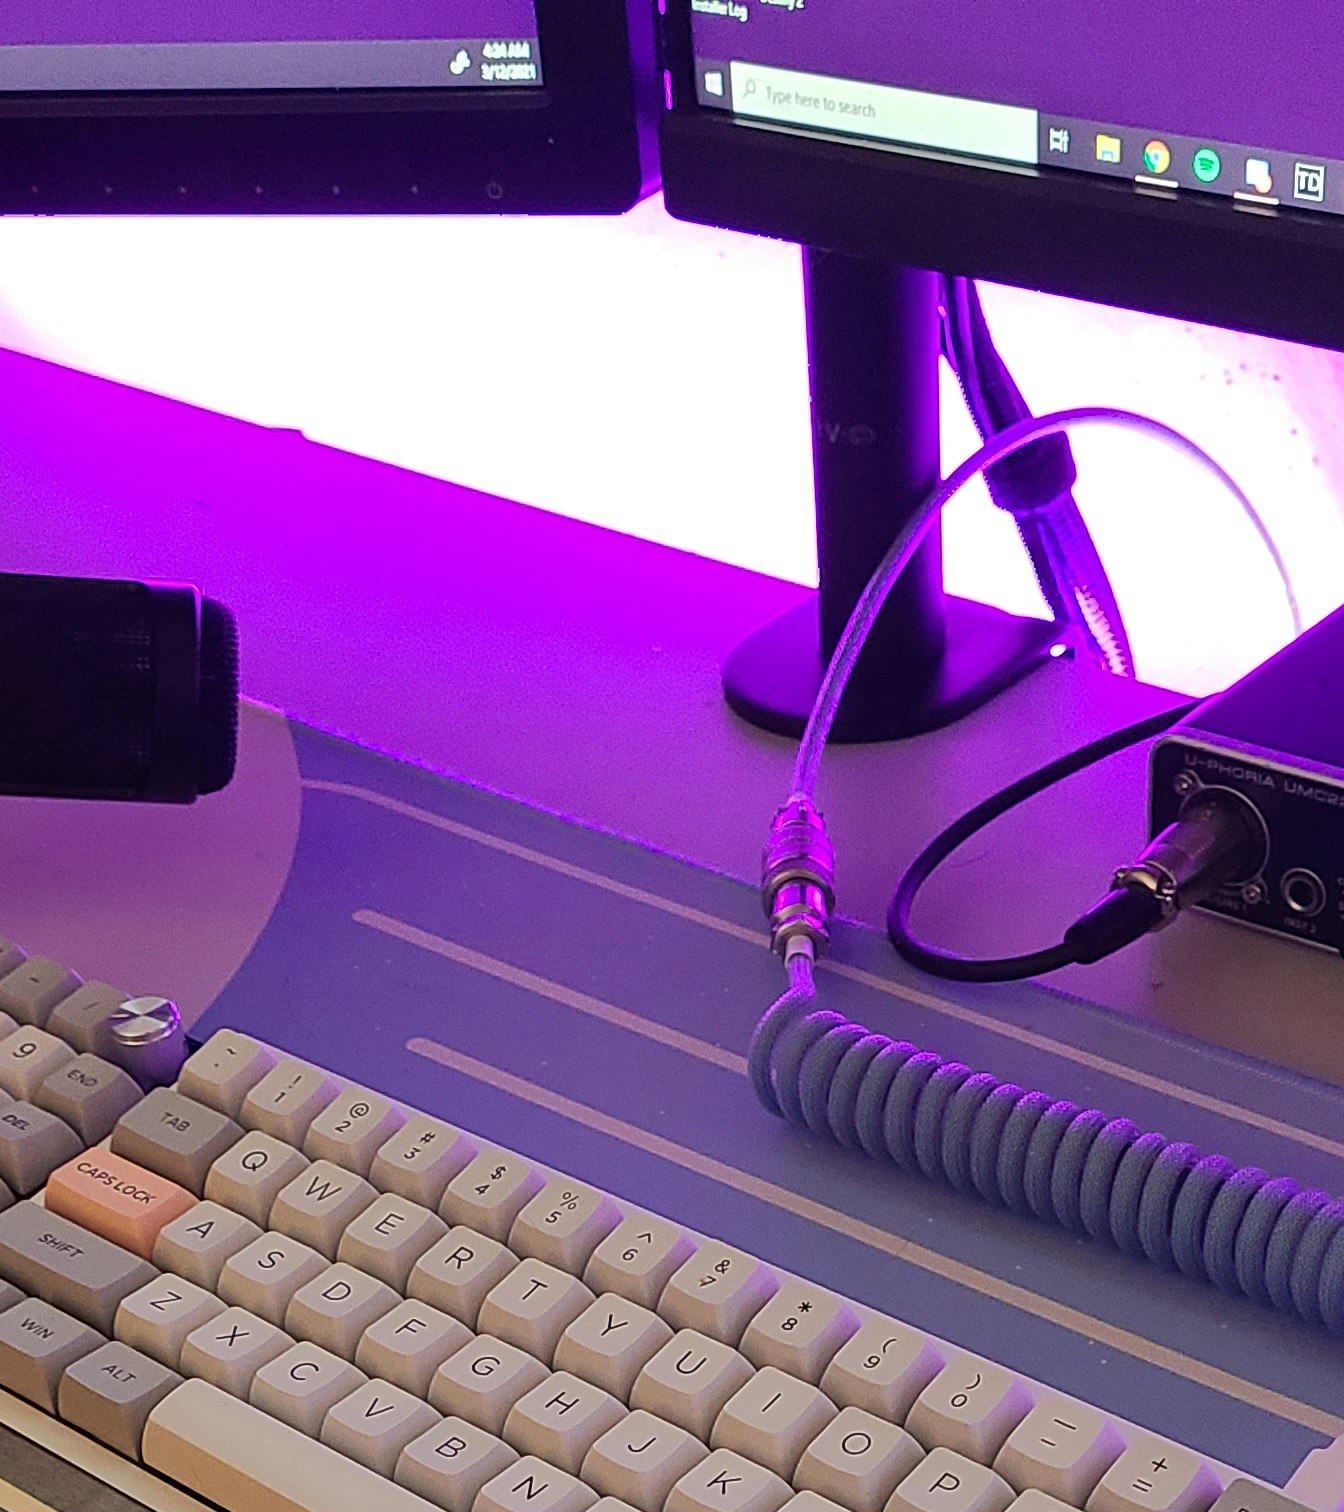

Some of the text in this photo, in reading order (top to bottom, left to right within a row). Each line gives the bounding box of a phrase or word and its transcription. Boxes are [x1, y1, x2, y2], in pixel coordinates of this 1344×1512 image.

[766, 86, 876, 118] Type here to search
[12, 1042, 37, 1059] 9
[66, 1068, 98, 1087] END
[274, 1091, 287, 1103] 1
[1, 1114, 30, 1131] DEL
[161, 1111, 191, 1132] TAB
[334, 1120, 352, 1133] 2
[241, 1150, 269, 1172] Q
[403, 1147, 421, 1160] 3
[77, 1162, 157, 1205] CAPS LOCK
[305, 1175, 343, 1202] W
[374, 1212, 405, 1235] E
[544, 1210, 562, 1224] 5
[185, 1221, 215, 1239] A
[37, 1233, 84, 1258] SHIFT
[622, 1248, 639, 1261] 6
[257, 1250, 285, 1269] S
[444, 1246, 474, 1270] R
[321, 1281, 352, 1301] D
[521, 1278, 549, 1301] T
[699, 1275, 717, 1287] 7
[149, 1291, 183, 1311] Z
[20, 1318, 55, 1339] WIN
[394, 1318, 427, 1334] F
[600, 1313, 629, 1337] Y
[781, 1317, 799, 1331] 8
[215, 1325, 250, 1347] X
[289, 1362, 320, 1381] C
[471, 1356, 501, 1376] G
[675, 1350, 707, 1375] U
[863, 1355, 881, 1369] 9
[101, 1365, 137, 1383] ALT
[364, 1397, 395, 1418] V
[544, 1391, 580, 1416] H
[434, 1436, 467, 1458] B
[627, 1437, 657, 1453] J
[841, 1432, 872, 1456] O
[511, 1475, 549, 1501] N
[706, 1470, 742, 1496] K
[928, 1472, 961, 1493] P
